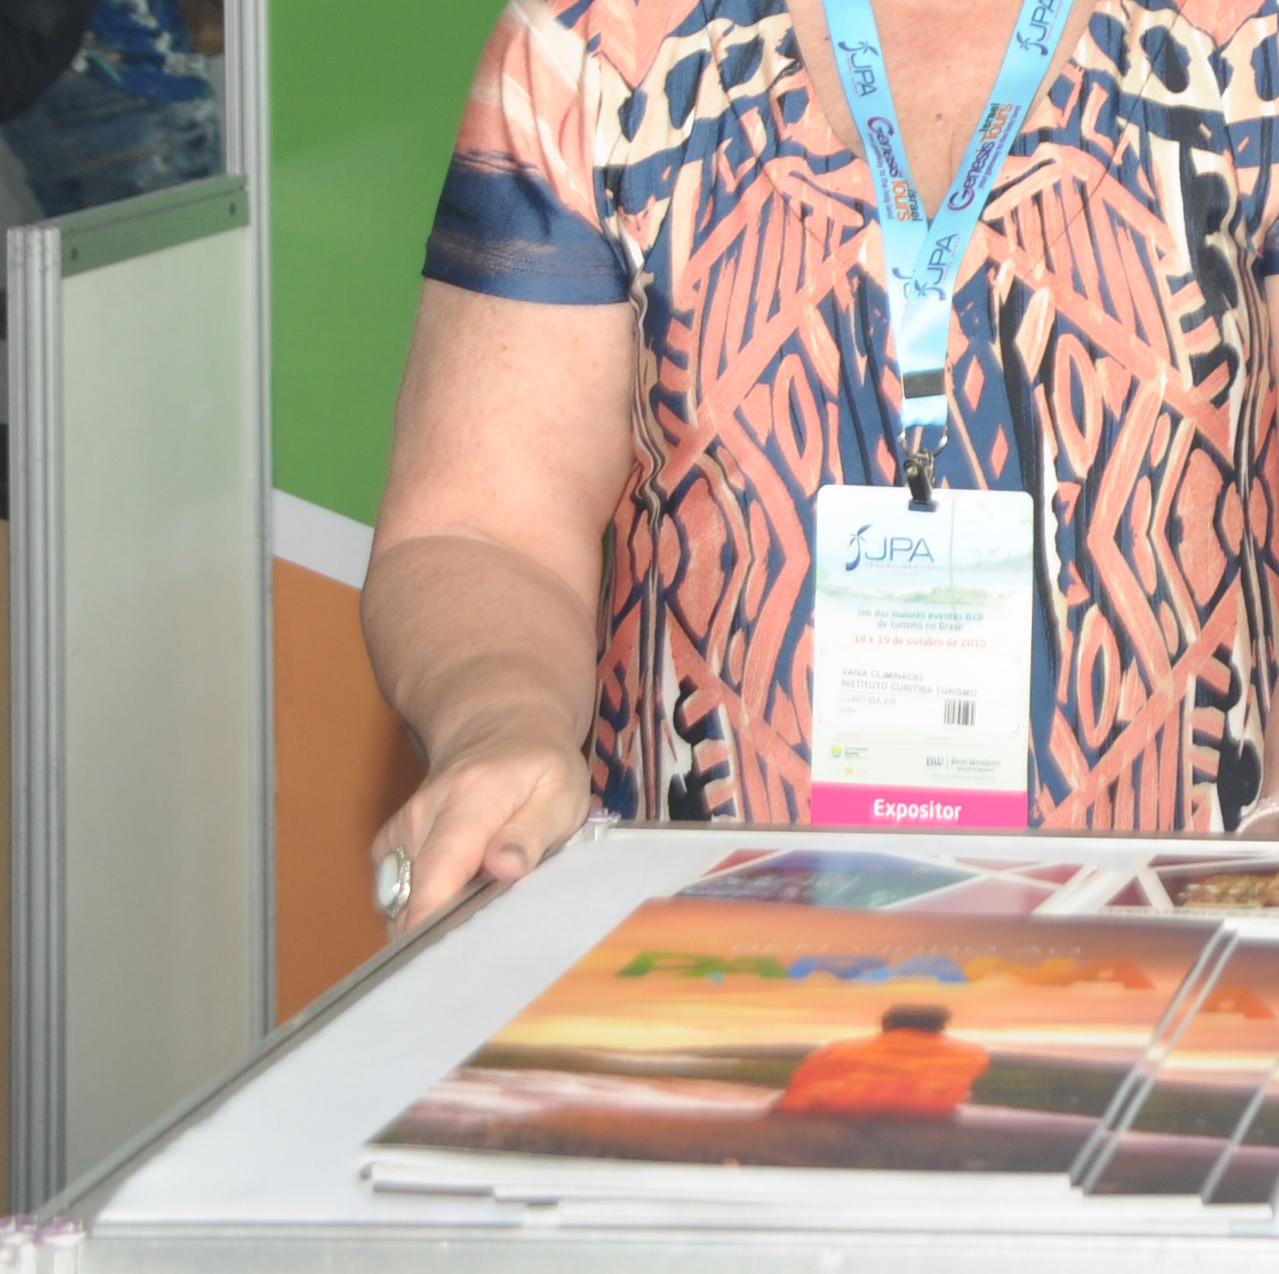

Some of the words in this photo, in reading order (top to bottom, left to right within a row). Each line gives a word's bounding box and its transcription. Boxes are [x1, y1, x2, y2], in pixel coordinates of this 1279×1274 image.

[976, 102, 1001, 132] Israel
[946, 139, 995, 212] Genesis
[979, 102, 1014, 142] Tours
[864, 536, 934, 563] JPA
[857, 607, 872, 618] Um
[877, 620, 887, 629] de
[890, 620, 923, 631] turismo
[925, 622, 937, 631] no
[938, 621, 963, 632] Brasil
[854, 633, 867, 644] 18
[877, 634, 890, 645] 19
[892, 635, 904, 646] de
[906, 636, 944, 647] outubro
[946, 636, 958, 647] de
[960, 637, 987, 648] 2019
[841, 666, 869, 678] VANIA
[840, 678, 889, 691] INSTITUTO
[890, 682, 934, 694] CURITIBA
[936, 686, 978, 698] TURISMO
[873, 798, 962, 821] Expositor
